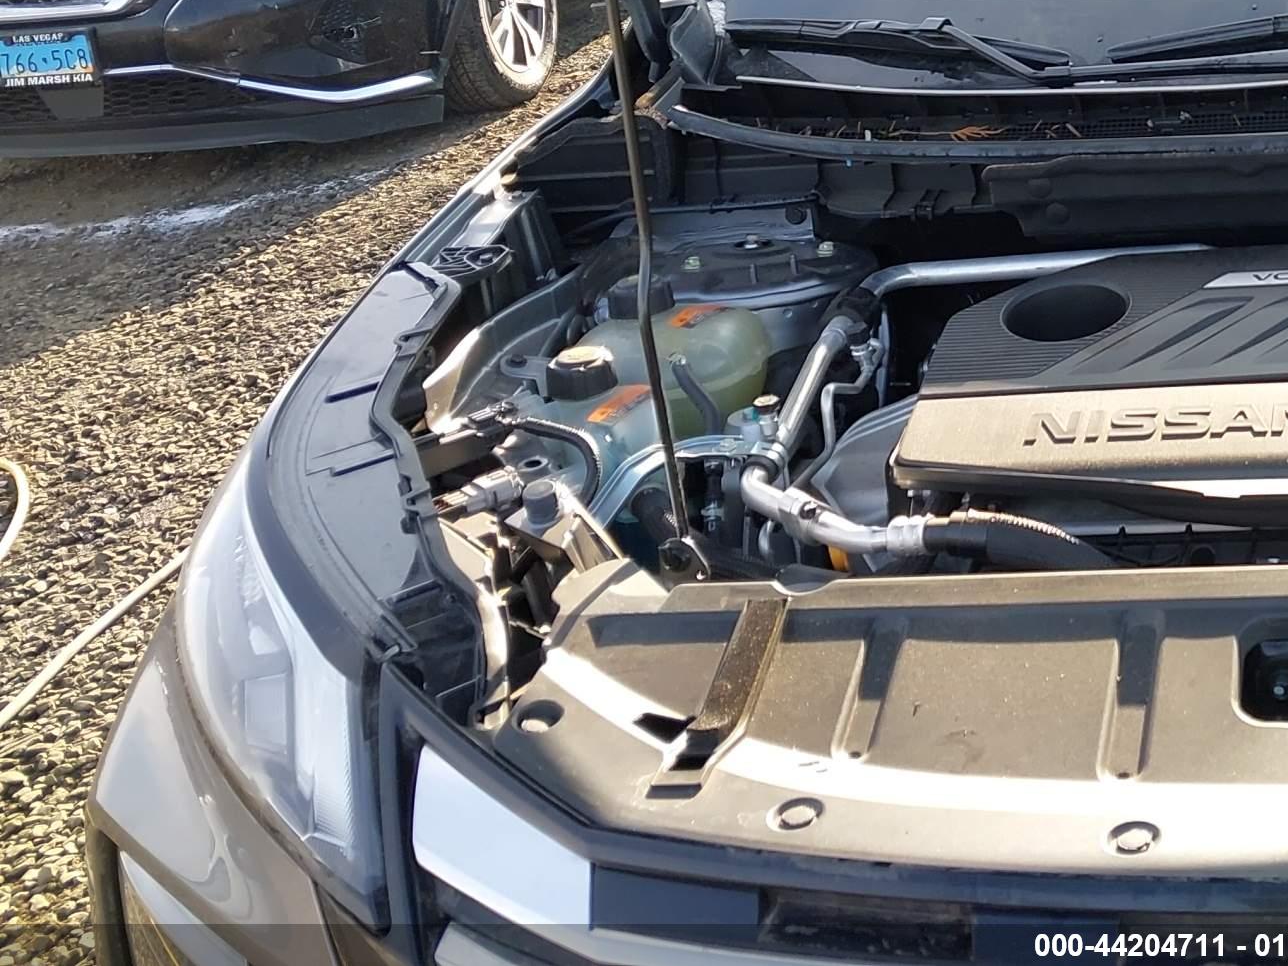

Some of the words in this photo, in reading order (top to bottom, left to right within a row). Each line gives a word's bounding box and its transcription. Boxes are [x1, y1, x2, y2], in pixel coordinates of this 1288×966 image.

[12, 35, 30, 43] LAS
[5, 77, 25, 87] JIM
[28, 75, 70, 85] MARSH
[73, 73, 94, 82] KIA
